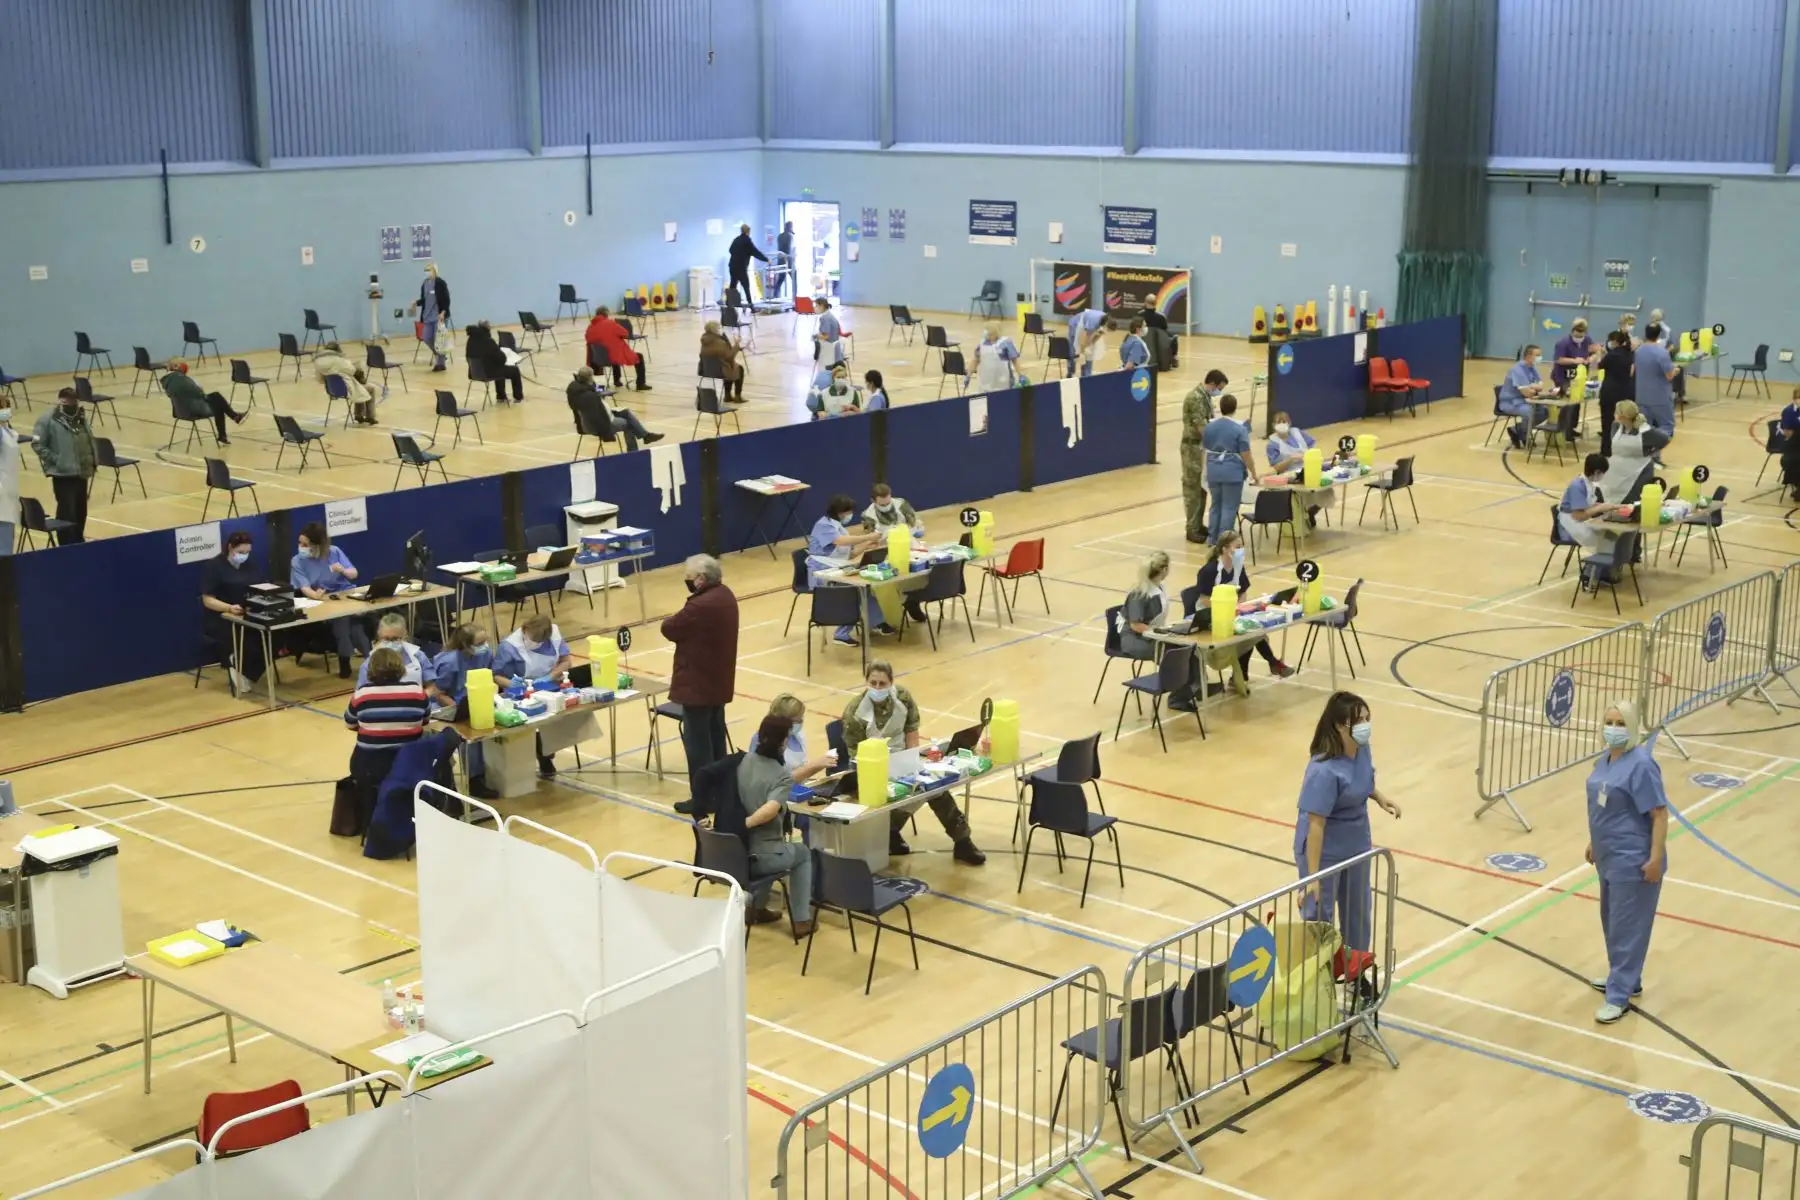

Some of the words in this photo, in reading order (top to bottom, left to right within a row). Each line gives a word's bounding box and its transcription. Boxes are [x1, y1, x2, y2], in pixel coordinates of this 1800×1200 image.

[194, 239, 201, 250] 7
[1106, 271, 1164, 283] #KeepWalesSafe
[1341, 438, 1354, 449] 14
[1696, 467, 1705, 480] 3
[328, 508, 353, 518] Clinical
[963, 511, 977, 523] 15
[329, 517, 361, 527] Controller
[179, 535, 203, 544] Admin
[180, 543, 216, 554] Controller
[1302, 562, 1313, 578] 2
[619, 630, 630, 646] 13
[984, 701, 989, 720] 1
